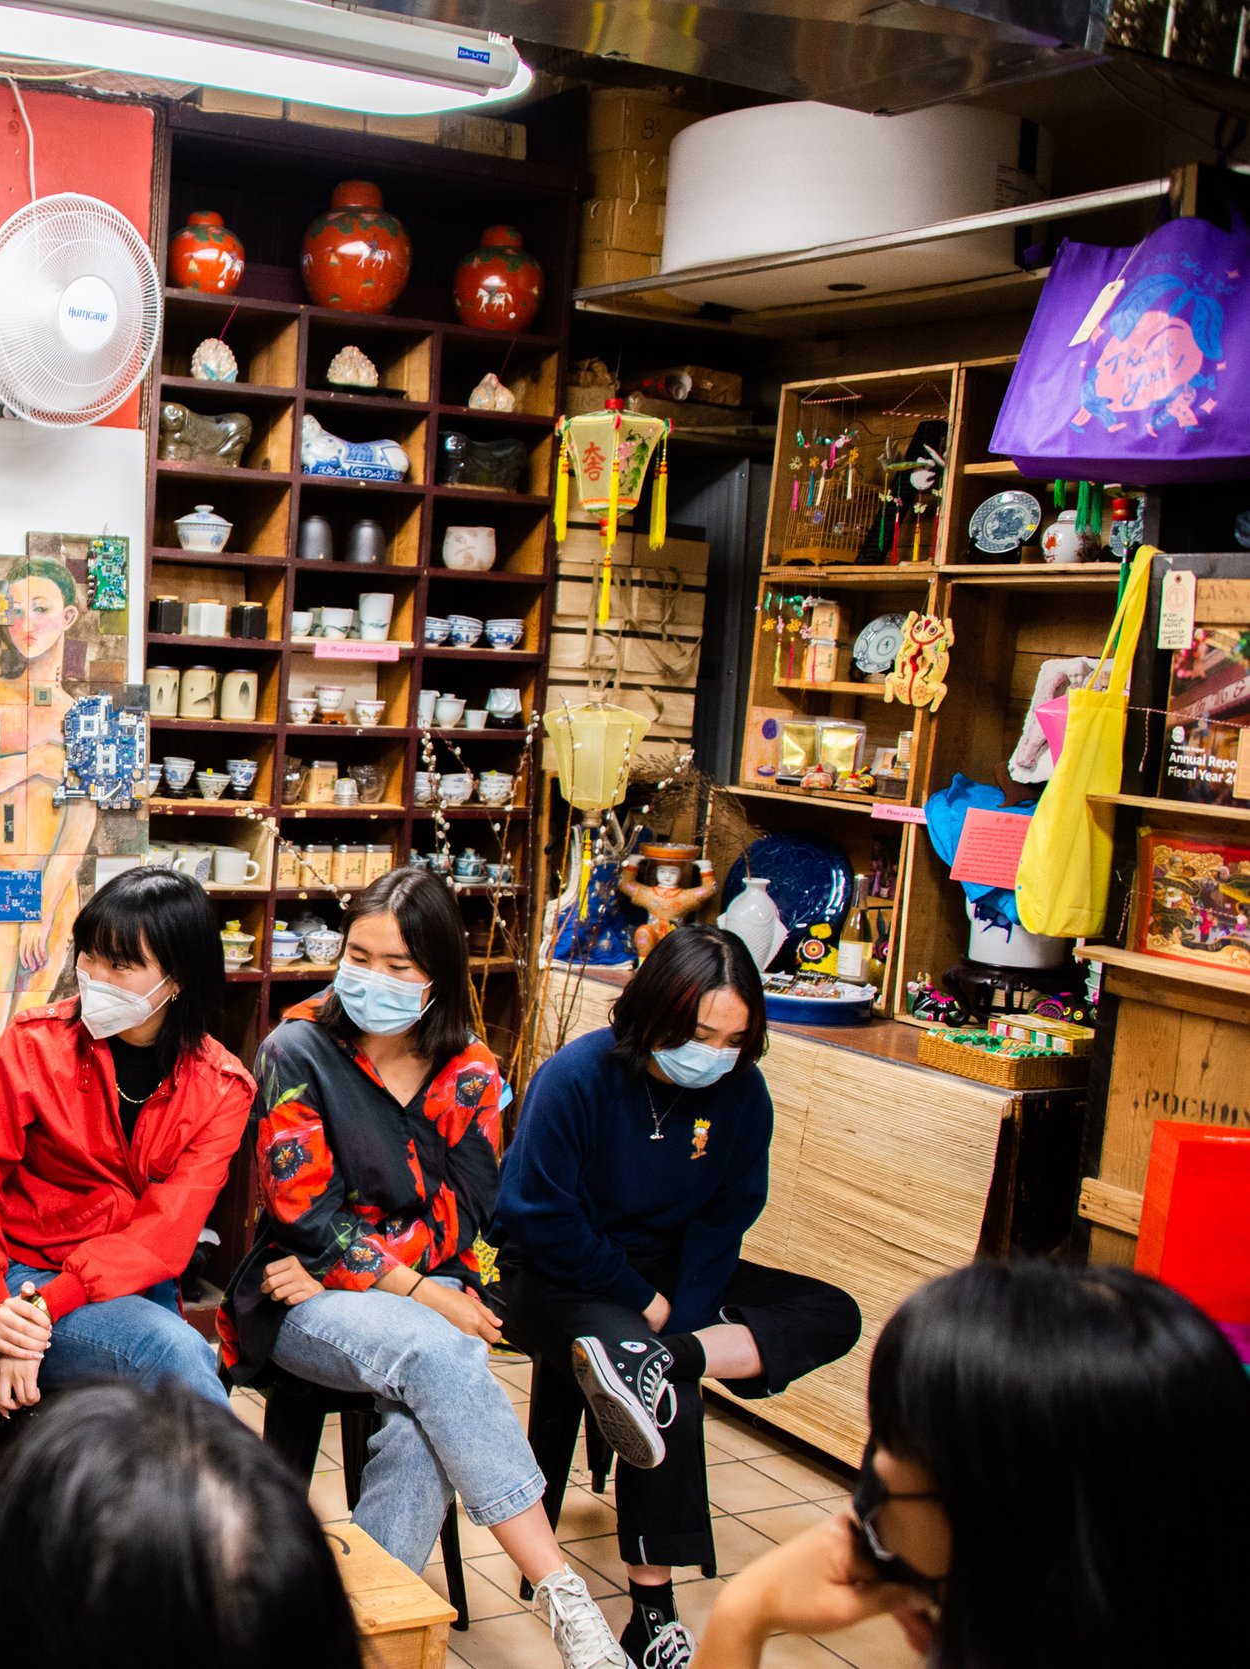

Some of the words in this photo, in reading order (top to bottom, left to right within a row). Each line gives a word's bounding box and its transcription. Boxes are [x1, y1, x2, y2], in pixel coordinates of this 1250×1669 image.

[458, 49, 489, 61] DA-LITE
[68, 306, 108, 323] Hurricane
[1169, 752, 1206, 766] Annual
[1208, 755, 1238, 771] Repo
[1167, 765, 1197, 780] Fiscal
[1198, 769, 1224, 784] Year
